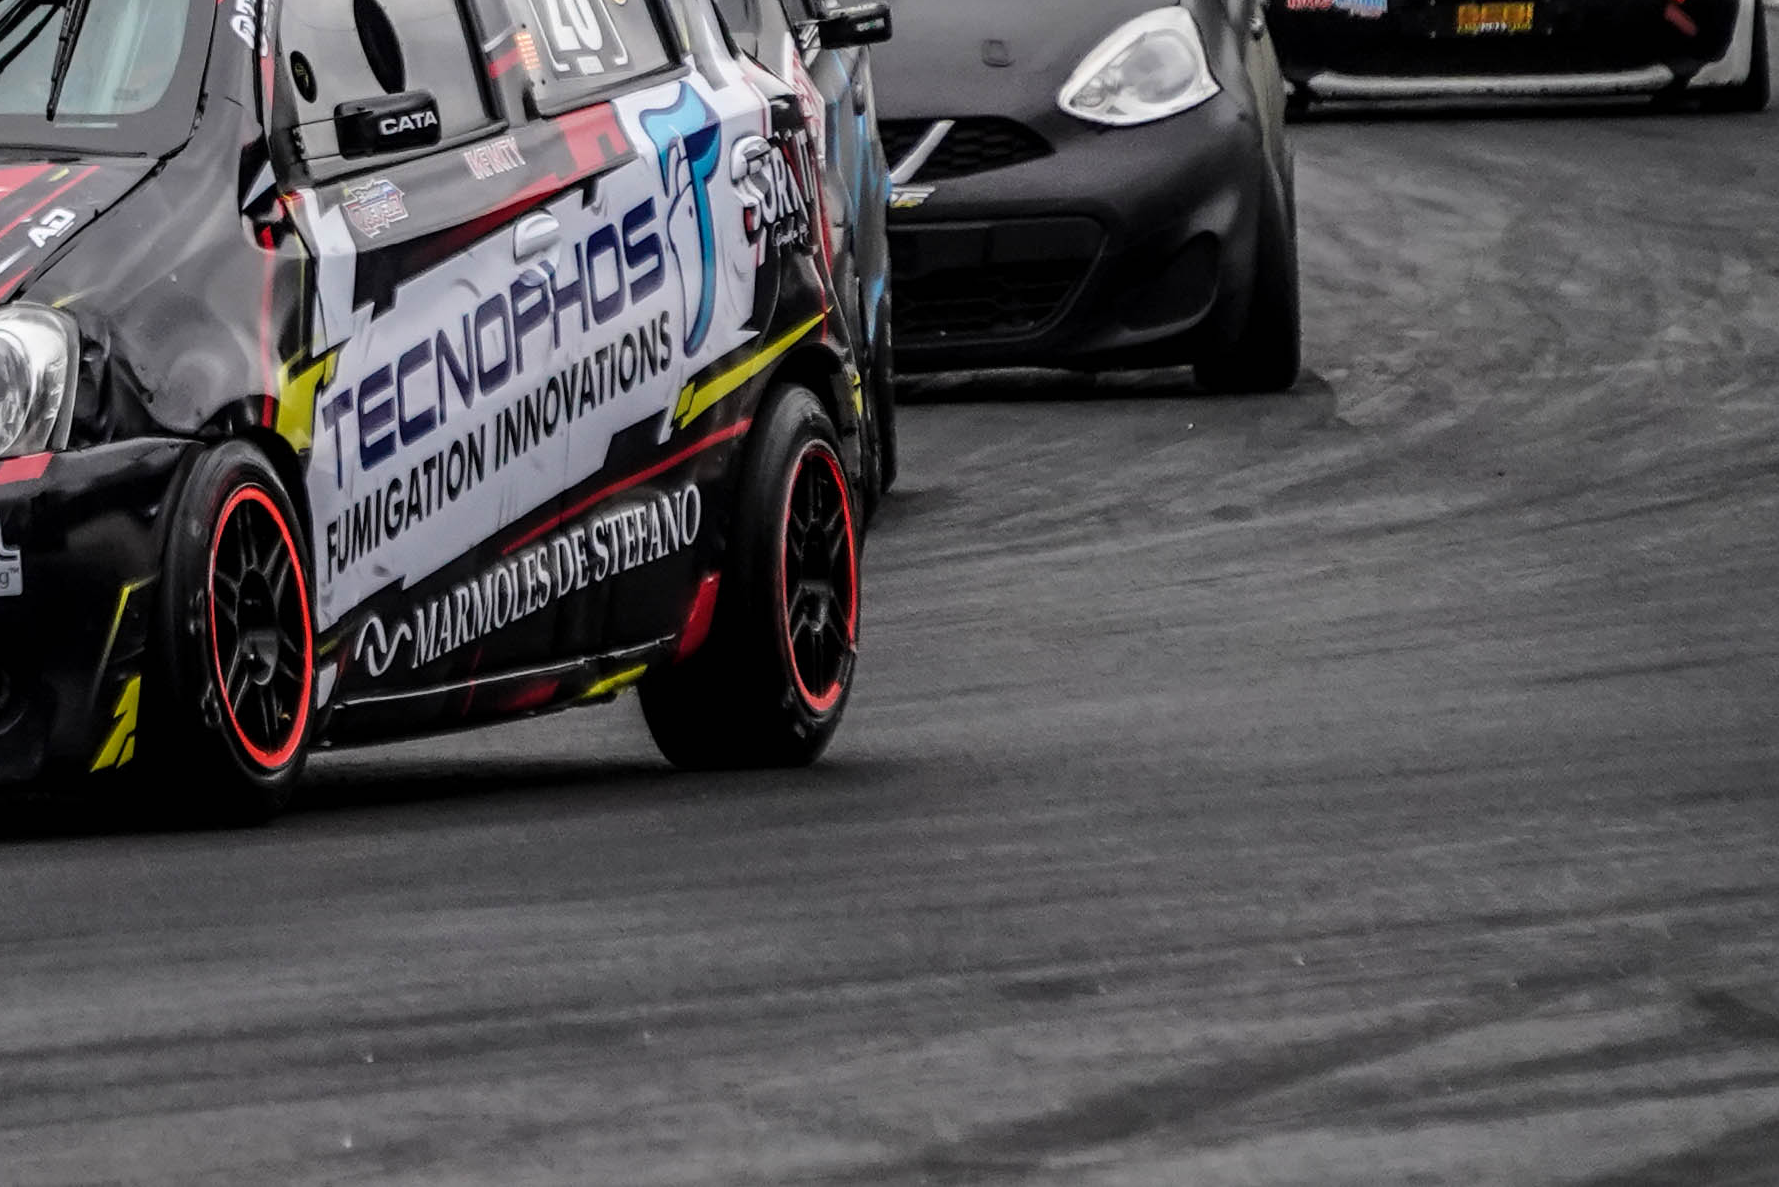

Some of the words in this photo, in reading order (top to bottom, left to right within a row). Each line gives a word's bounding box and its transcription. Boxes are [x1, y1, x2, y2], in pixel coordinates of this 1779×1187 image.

[379, 110, 439, 136] CATA
[28, 208, 76, 248] AD
[322, 196, 666, 490] TECNOPHOS
[326, 422, 487, 584] FUMIGATION
[494, 310, 673, 472] INNOVATIONS
[411, 545, 554, 670] MARMOLES
[554, 529, 591, 599] DE
[591, 482, 702, 582] STEFANO
